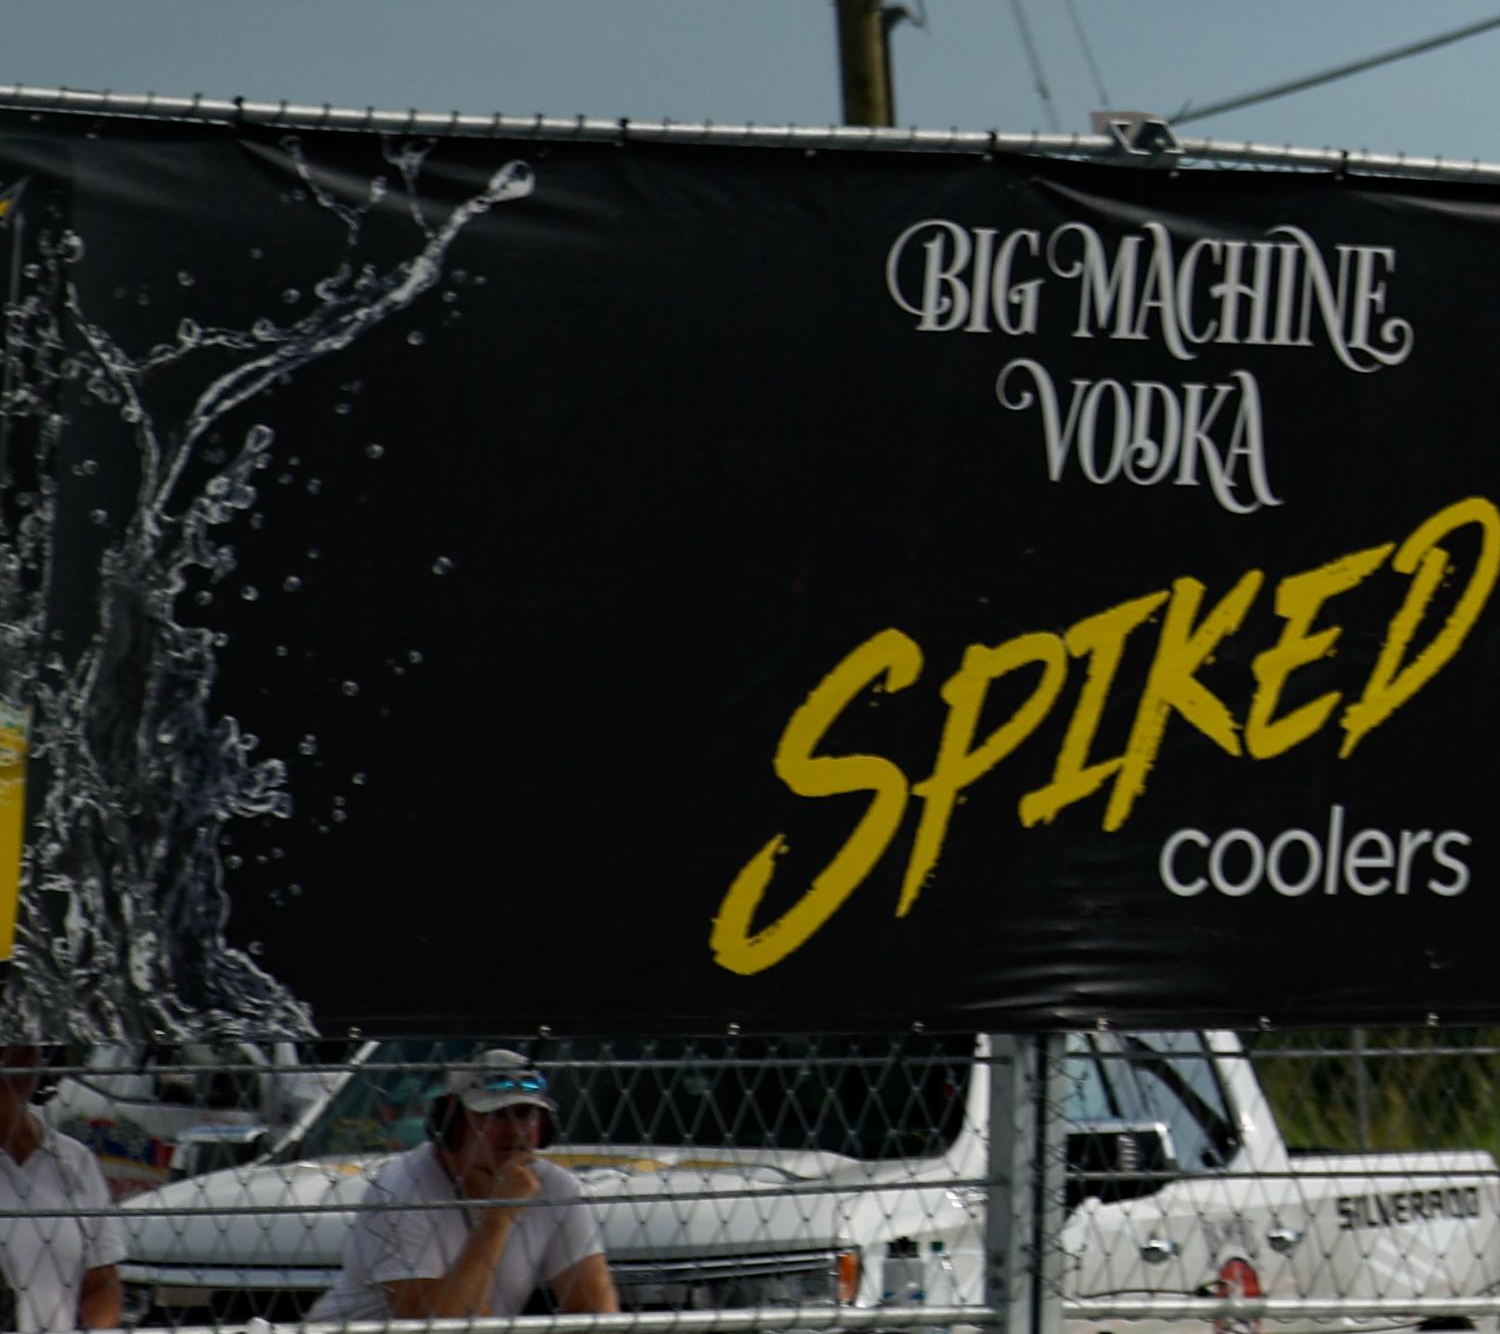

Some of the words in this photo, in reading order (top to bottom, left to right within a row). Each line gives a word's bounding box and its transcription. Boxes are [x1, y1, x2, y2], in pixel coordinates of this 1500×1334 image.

[885, 219, 1042, 337] BIG
[1047, 219, 1414, 374] MACHINE
[996, 358, 1283, 514] VODKA
[1158, 805, 1471, 897] coolers
[1336, 1185, 1480, 1232] SILVERADO
